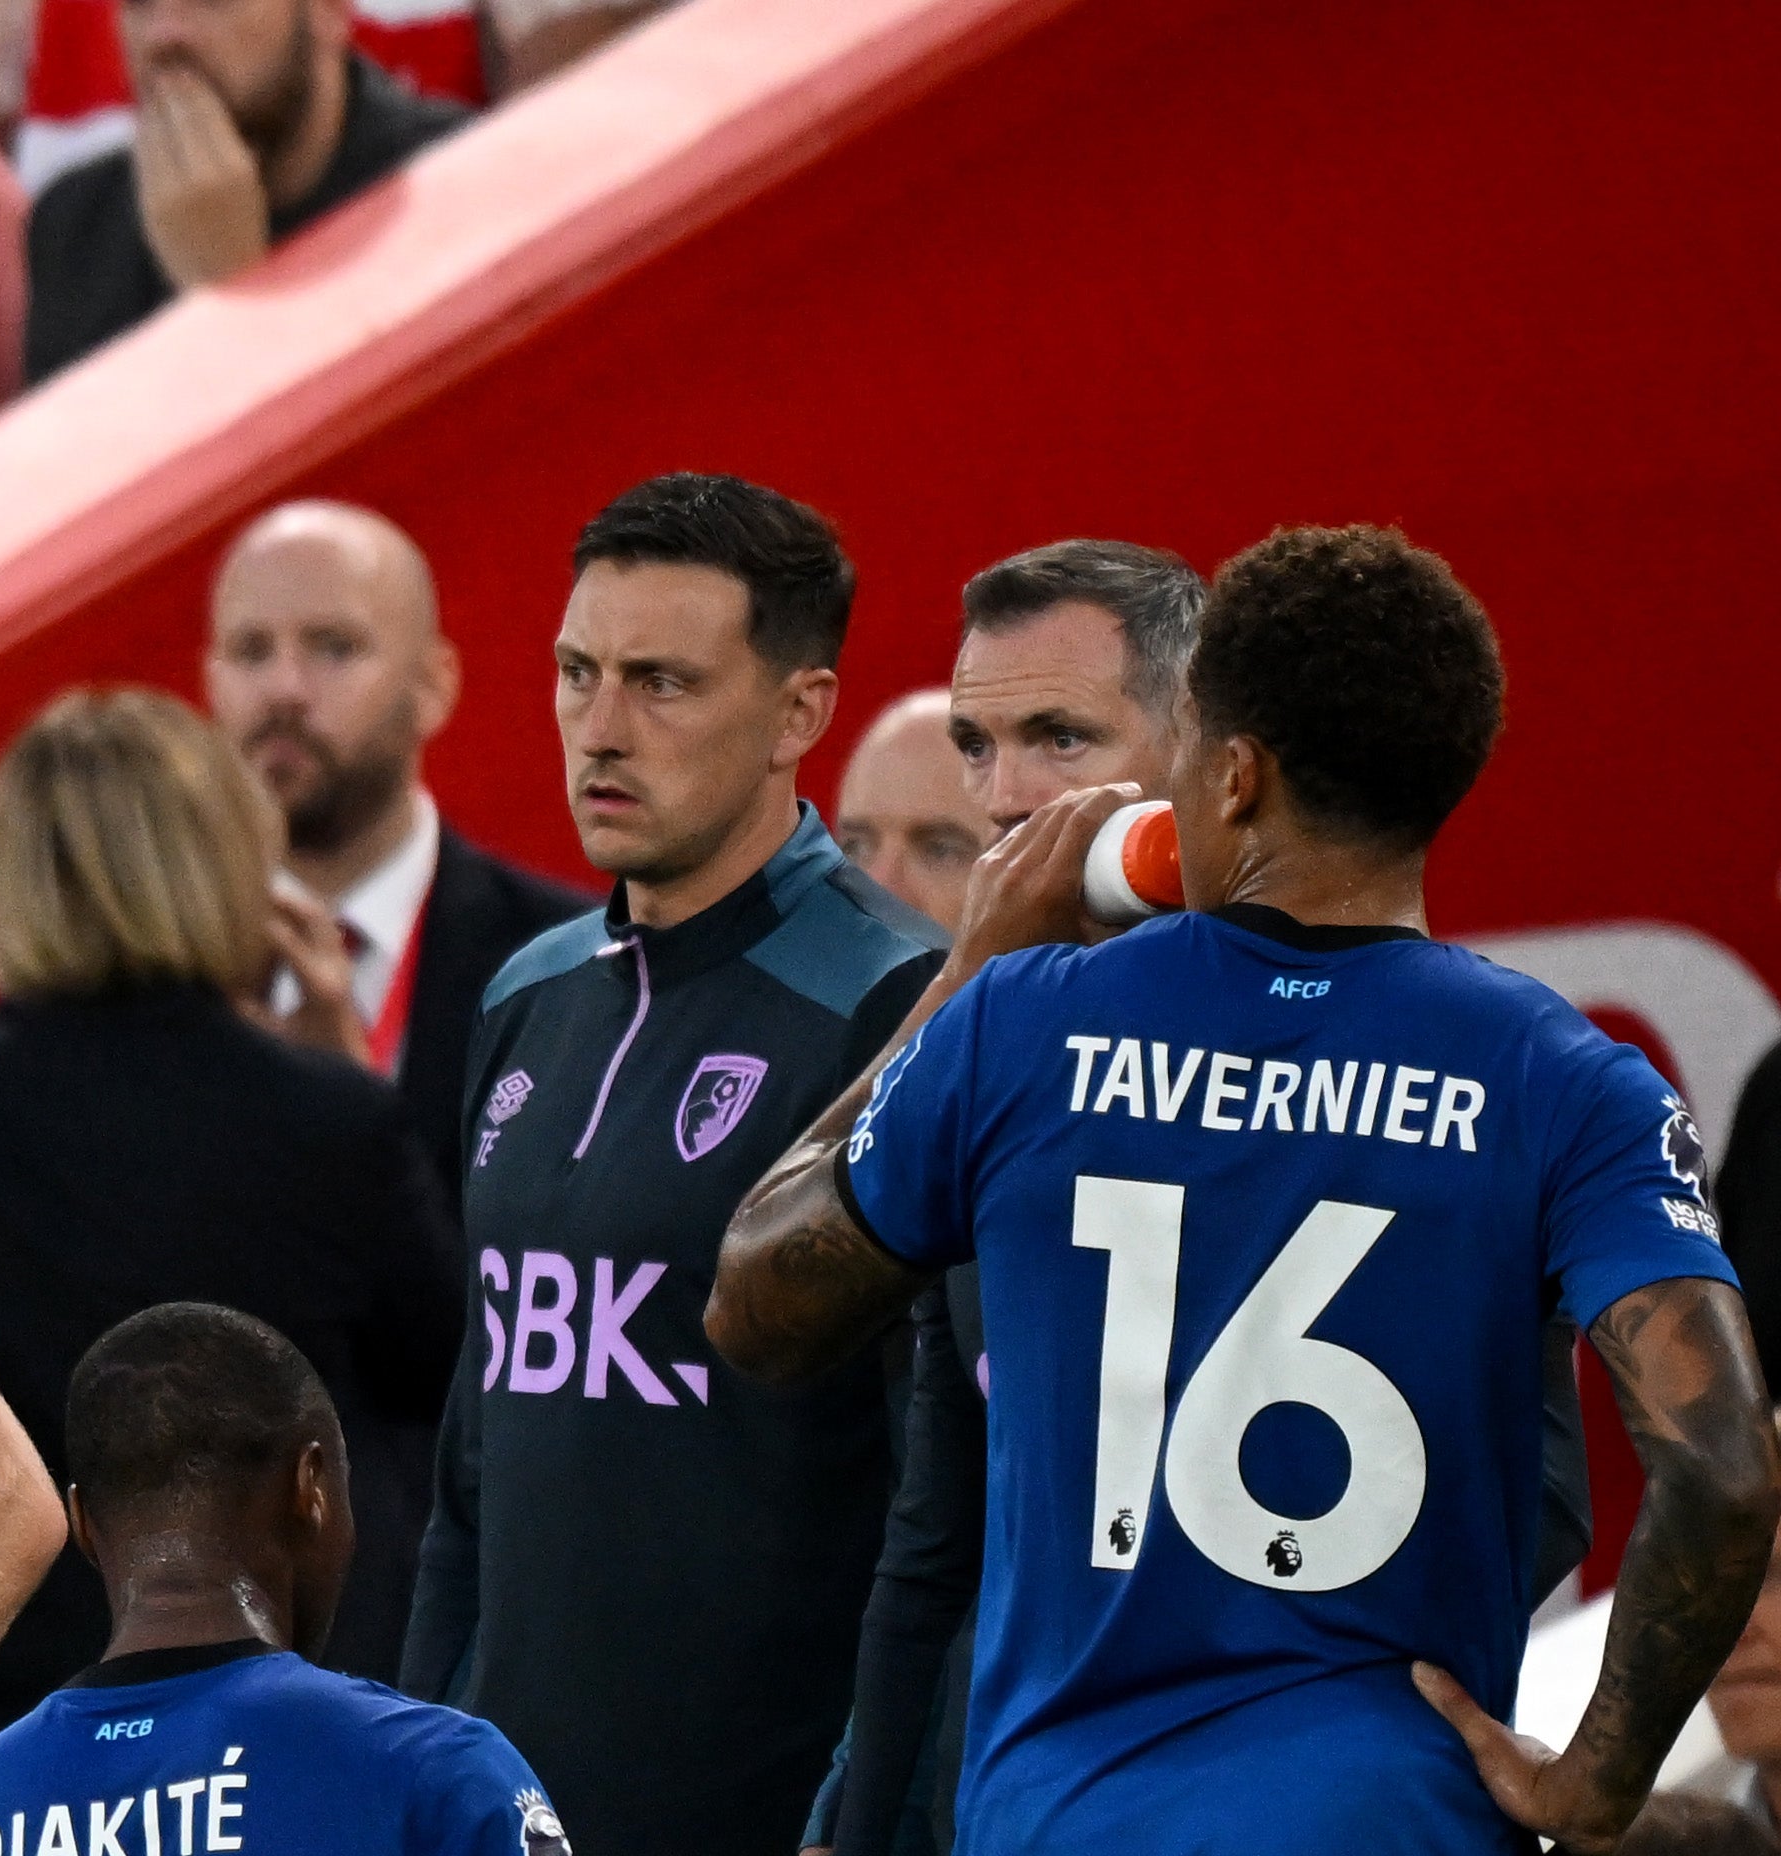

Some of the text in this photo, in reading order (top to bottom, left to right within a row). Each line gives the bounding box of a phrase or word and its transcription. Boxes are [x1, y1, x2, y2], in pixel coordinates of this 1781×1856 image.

[1269, 976, 1332, 1000] AFCB
[1065, 1035, 1487, 1153] TAVERNIER
[1072, 1174, 1427, 1592] 16
[95, 1719, 154, 1740] AFCB
